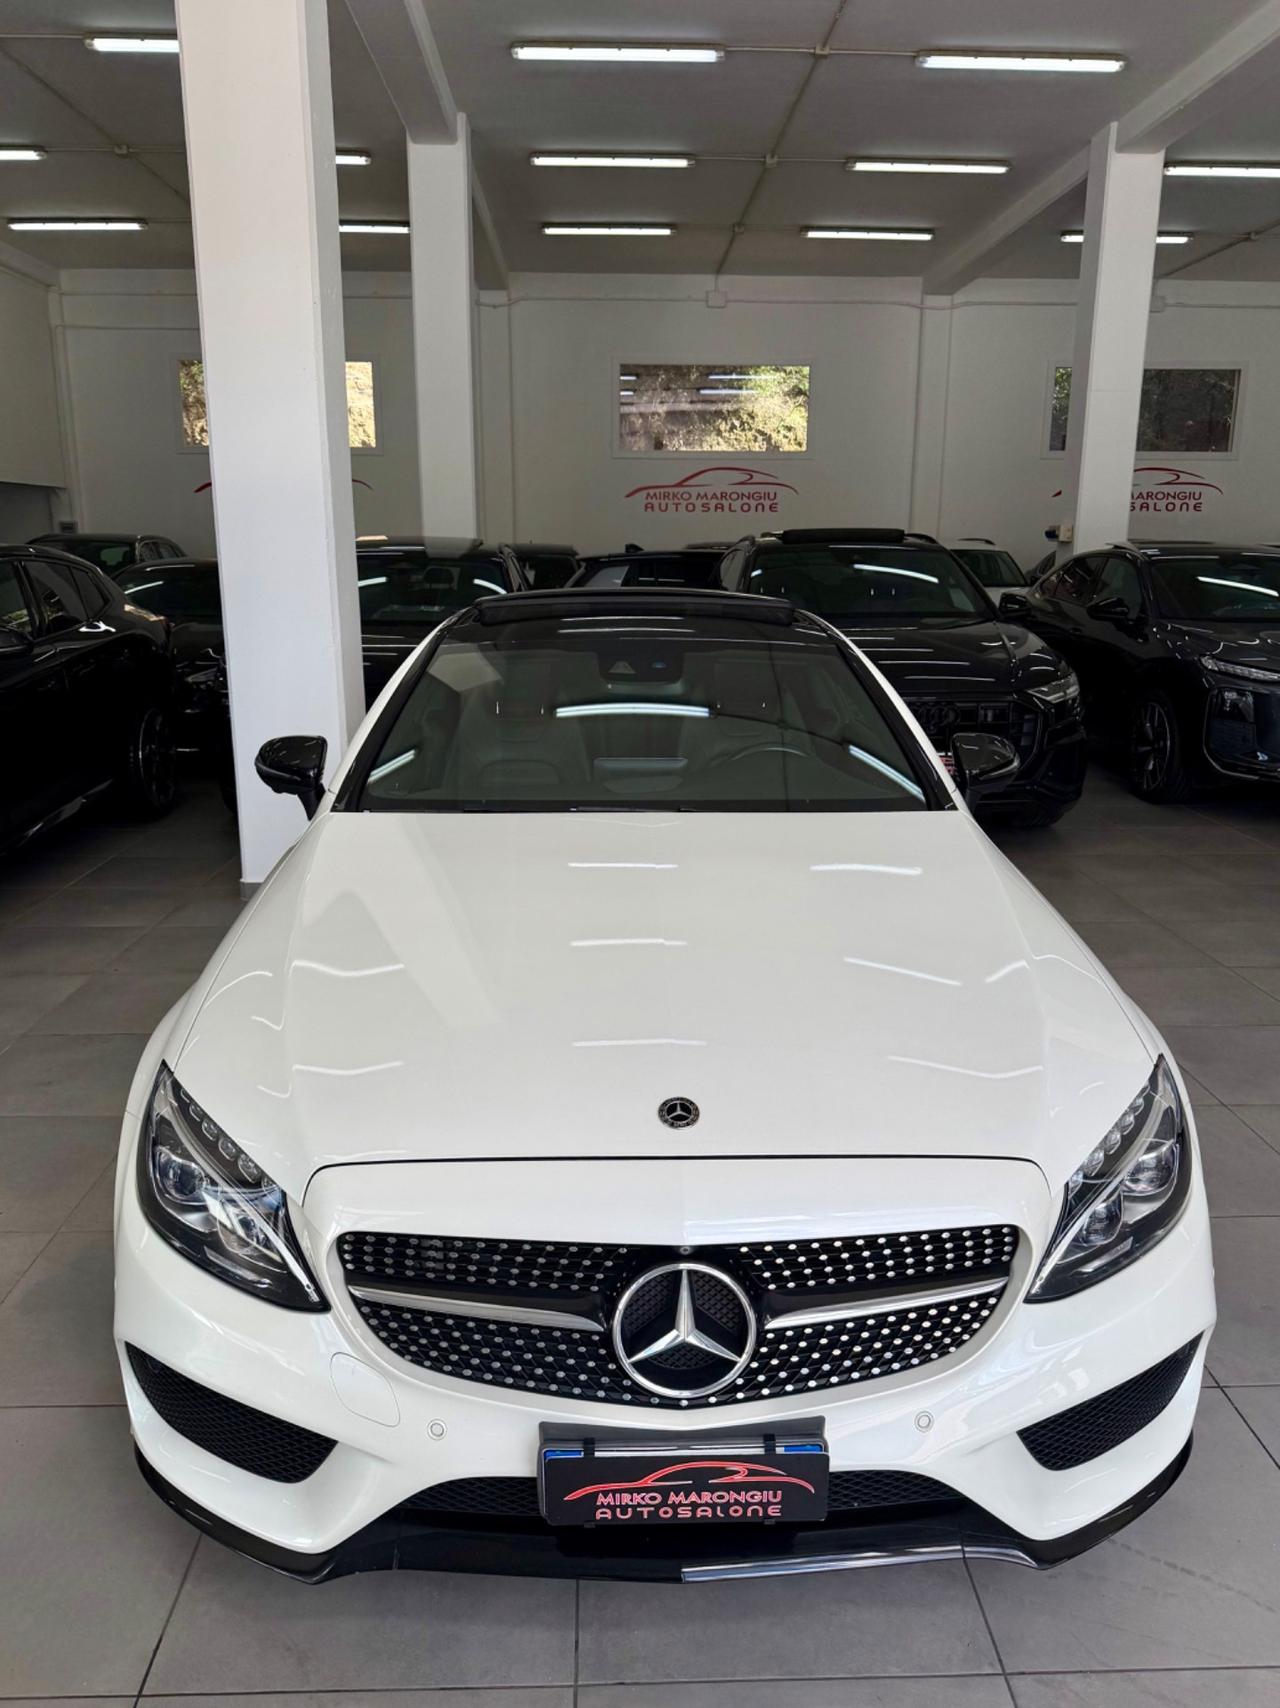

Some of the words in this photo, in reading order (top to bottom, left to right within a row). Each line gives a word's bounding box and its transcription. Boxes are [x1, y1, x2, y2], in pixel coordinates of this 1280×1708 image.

[645, 491, 691, 501] MIRKO
[696, 491, 777, 501] MARONGIU
[1131, 491, 1202, 501] ARONGIU
[644, 502, 778, 512] AUTOSALONE
[1130, 502, 1202, 512] SALONE
[596, 1492, 663, 1506] MIRKO
[667, 1490, 782, 1505] MARONGIU
[595, 1505, 782, 1520] AUTOSALONE
